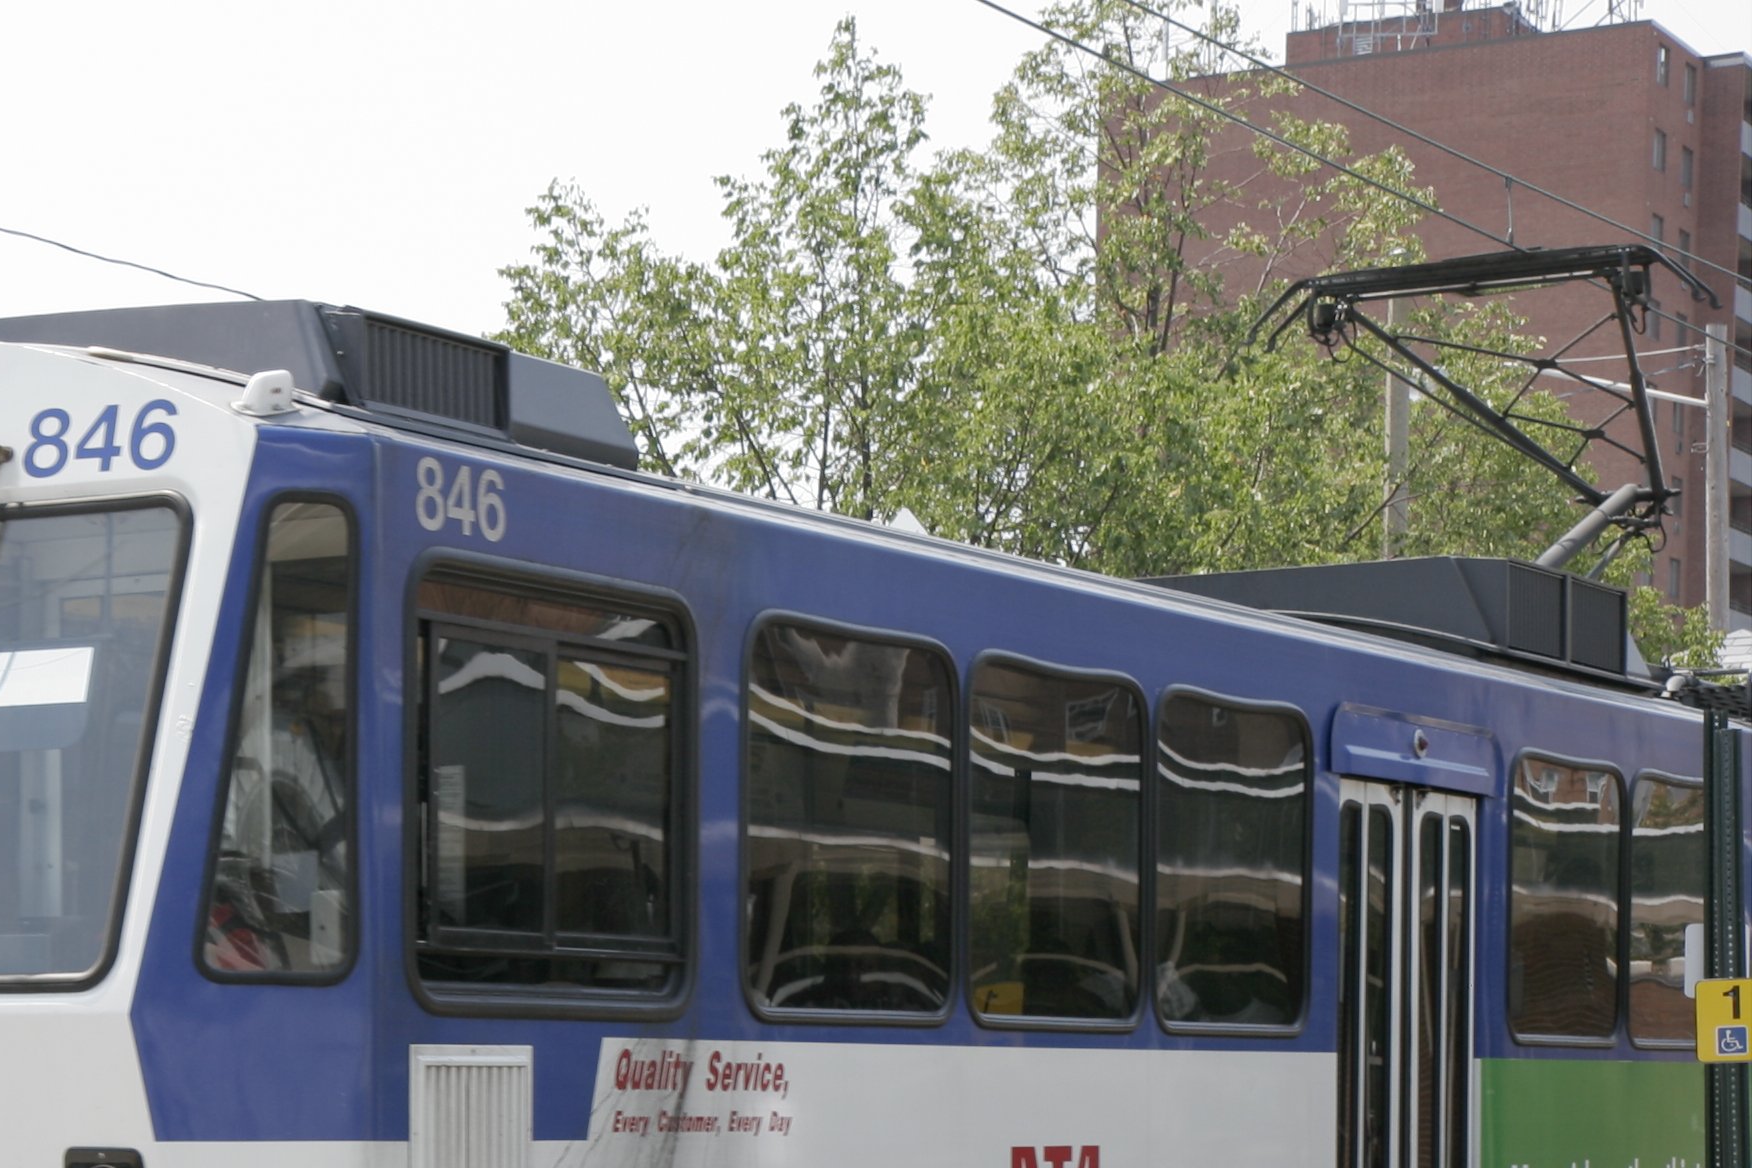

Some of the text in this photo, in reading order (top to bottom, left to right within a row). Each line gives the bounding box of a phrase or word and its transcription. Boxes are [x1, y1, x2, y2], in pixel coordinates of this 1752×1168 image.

[23, 398, 179, 478] 846
[414, 456, 507, 543] 846
[1722, 985, 1741, 1020] 1
[614, 1048, 790, 1101] Quality Service,
[611, 1110, 651, 1137] Every
[727, 1110, 764, 1137] Every
[768, 1111, 793, 1137] Day
